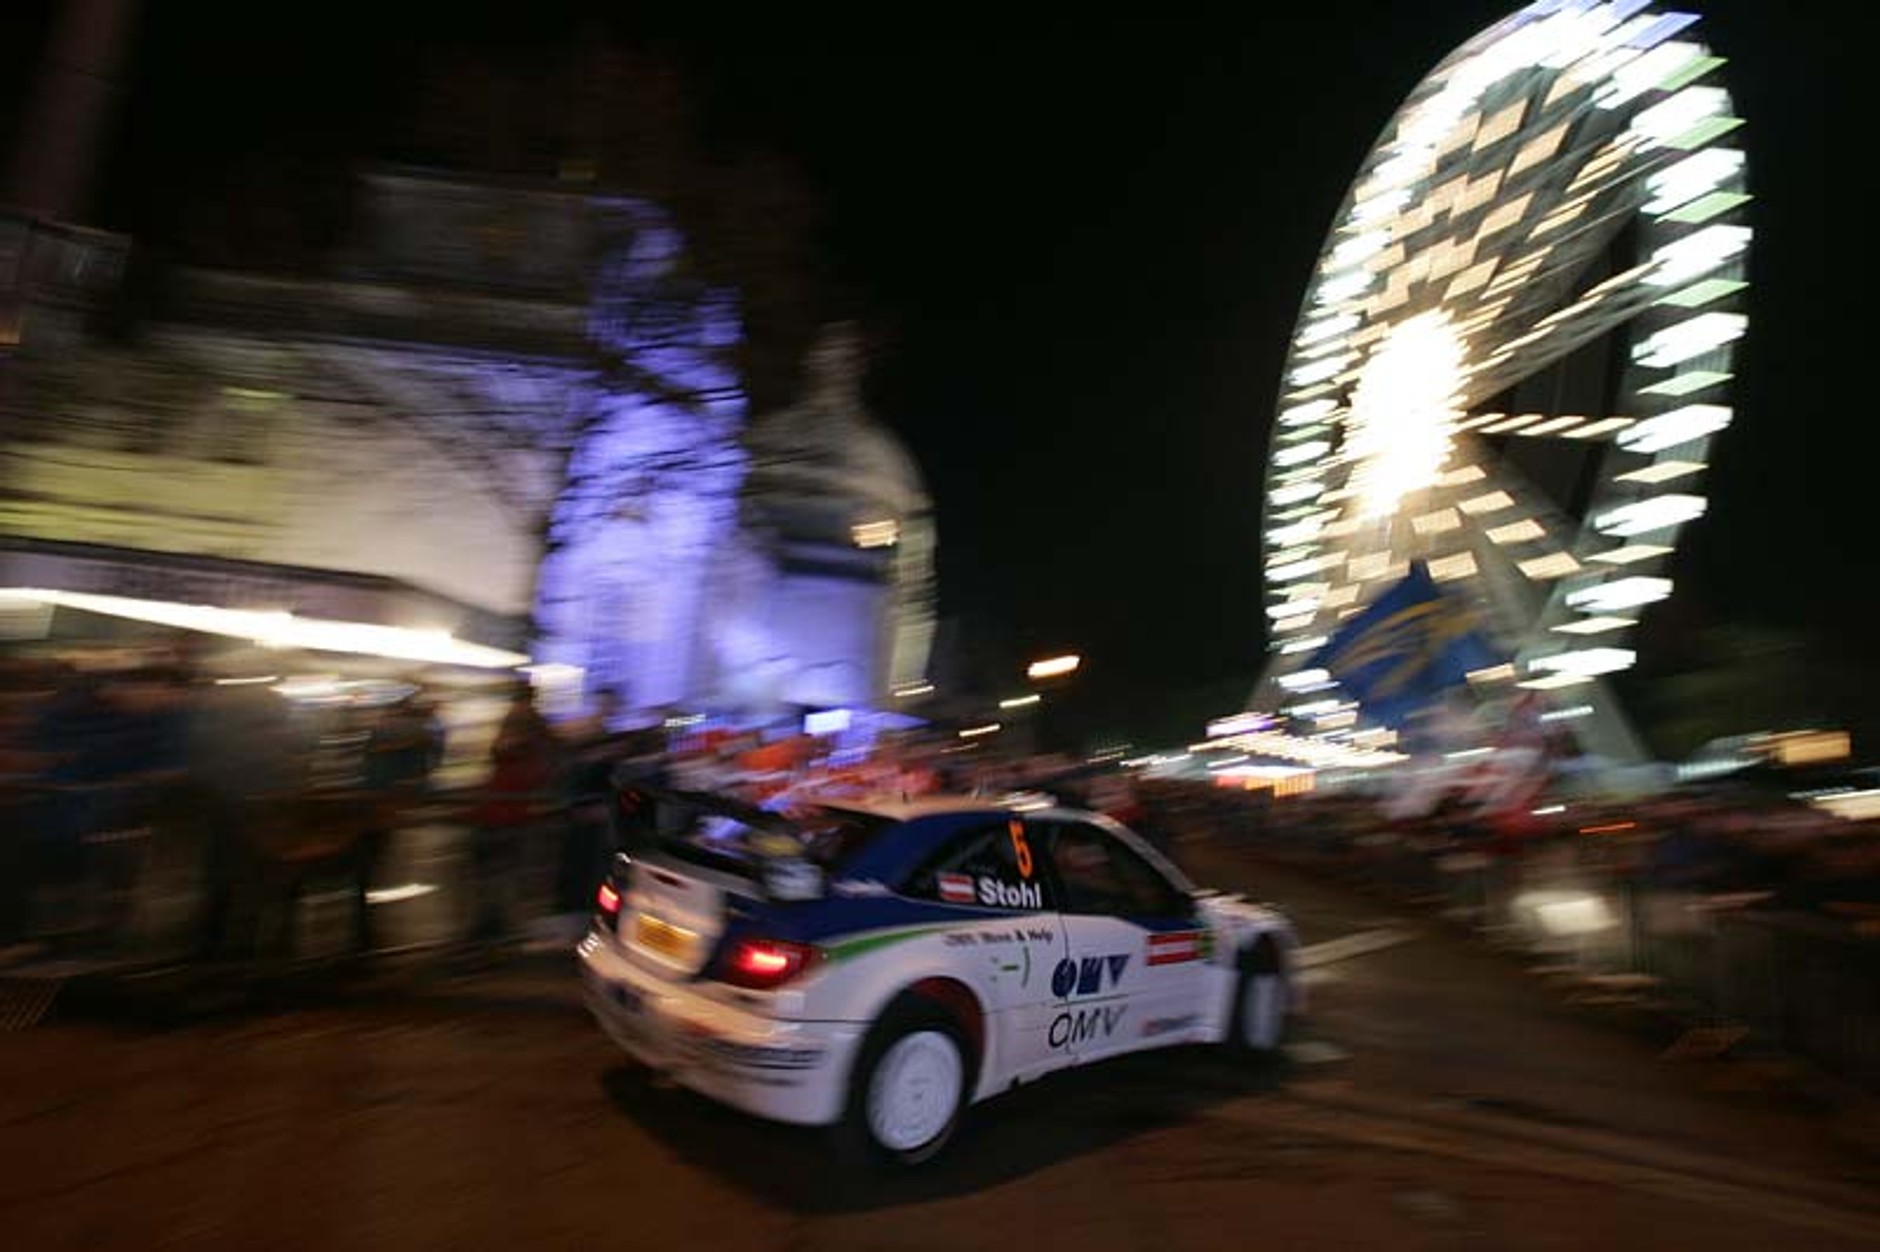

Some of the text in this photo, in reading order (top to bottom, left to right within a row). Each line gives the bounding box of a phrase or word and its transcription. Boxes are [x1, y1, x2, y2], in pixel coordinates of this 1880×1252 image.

[1008, 820, 1033, 878] 5
[979, 876, 1042, 908] Stohl
[1051, 954, 1130, 998] OMV
[1048, 1003, 1129, 1048] OMV
